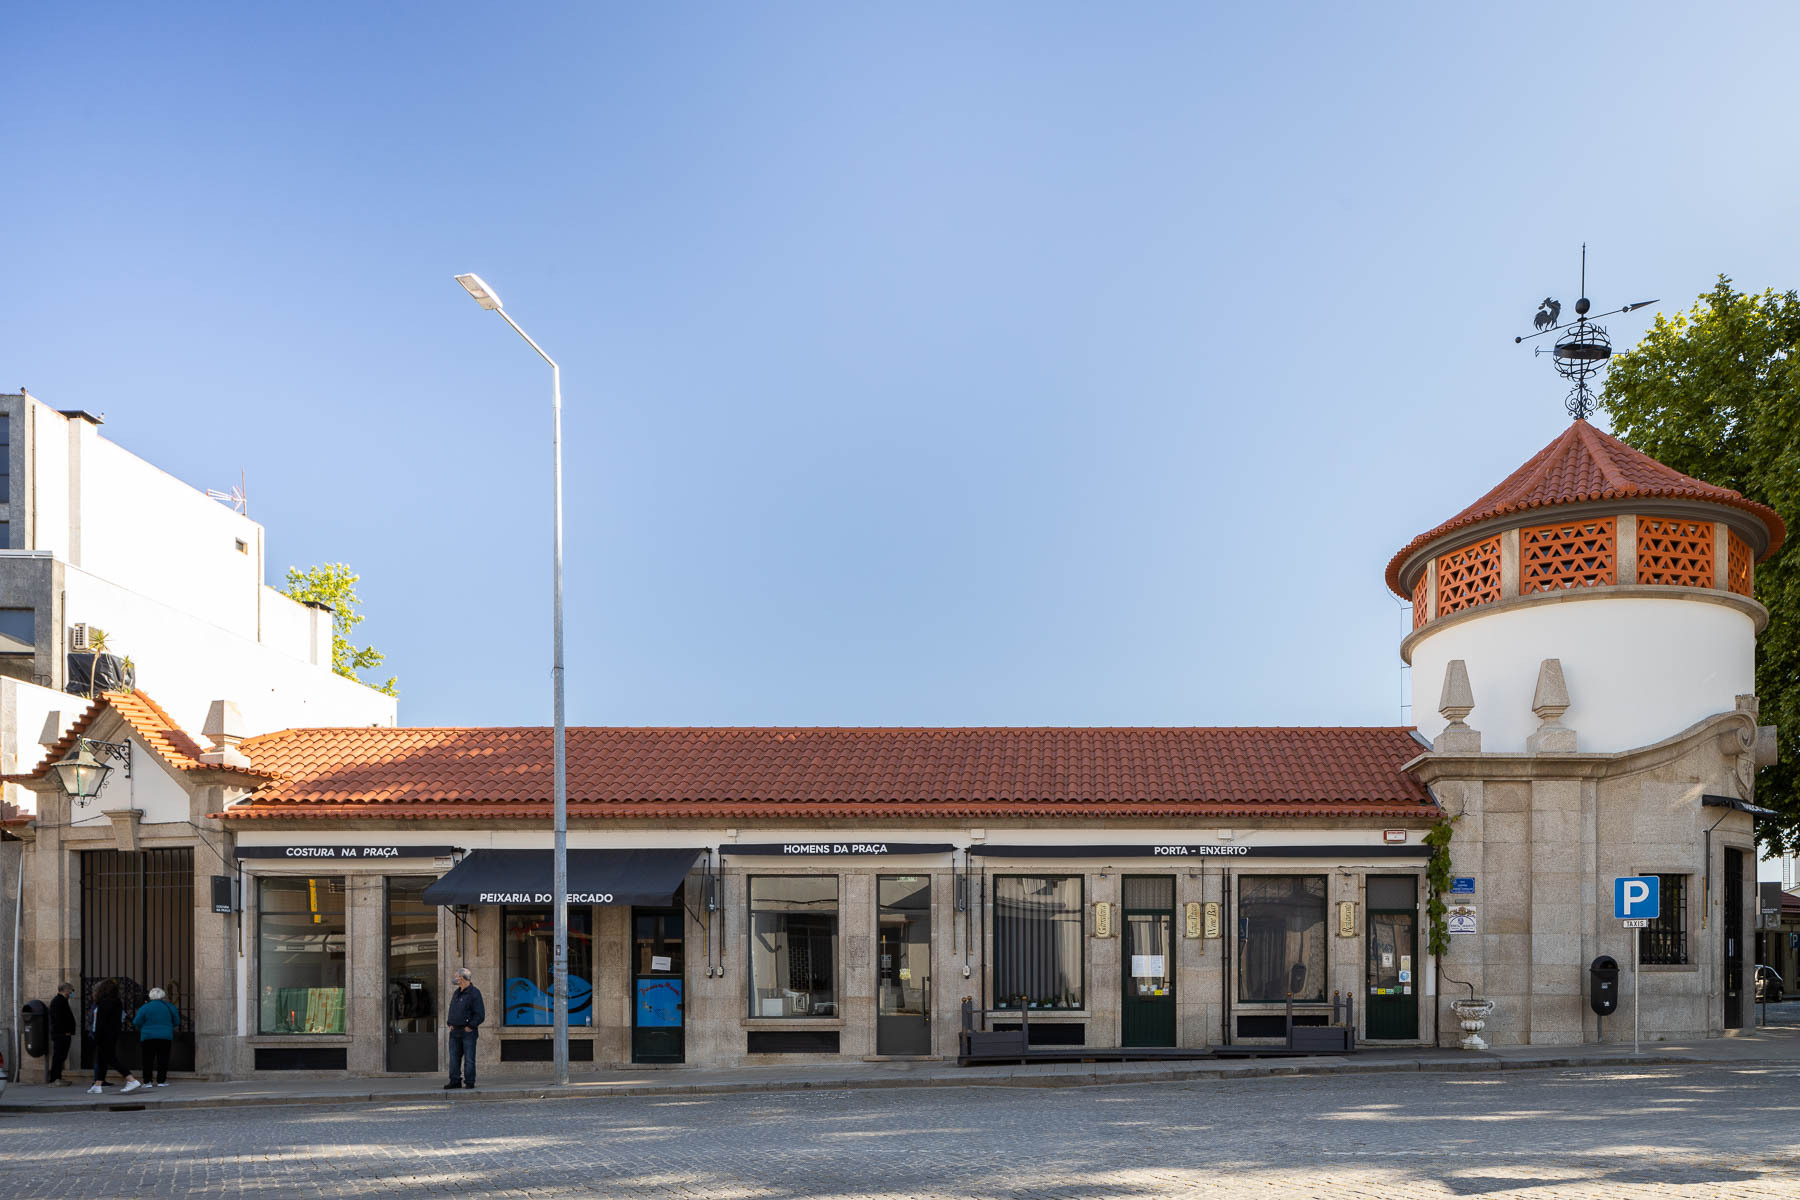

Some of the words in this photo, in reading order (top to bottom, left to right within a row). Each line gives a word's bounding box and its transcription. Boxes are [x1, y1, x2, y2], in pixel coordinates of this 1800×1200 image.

[286, 847, 335, 857] COSTURA
[341, 847, 357, 857] NA
[363, 847, 399, 858] PRAÇA
[783, 844, 830, 854] HOMENS
[833, 844, 849, 854] DA
[851, 844, 888, 855] PRAÇA
[1154, 846, 1188, 855] PORTA
[1199, 846, 1248, 855] ENXERTO
[479, 893, 531, 903] PEIXARIA
[534, 893, 552, 903] DO
[565, 893, 614, 903] ERCADO
[1623, 880, 1650, 915] P
[1207, 904, 1217, 917] Bar
[1625, 919, 1645, 927] TAXIS
